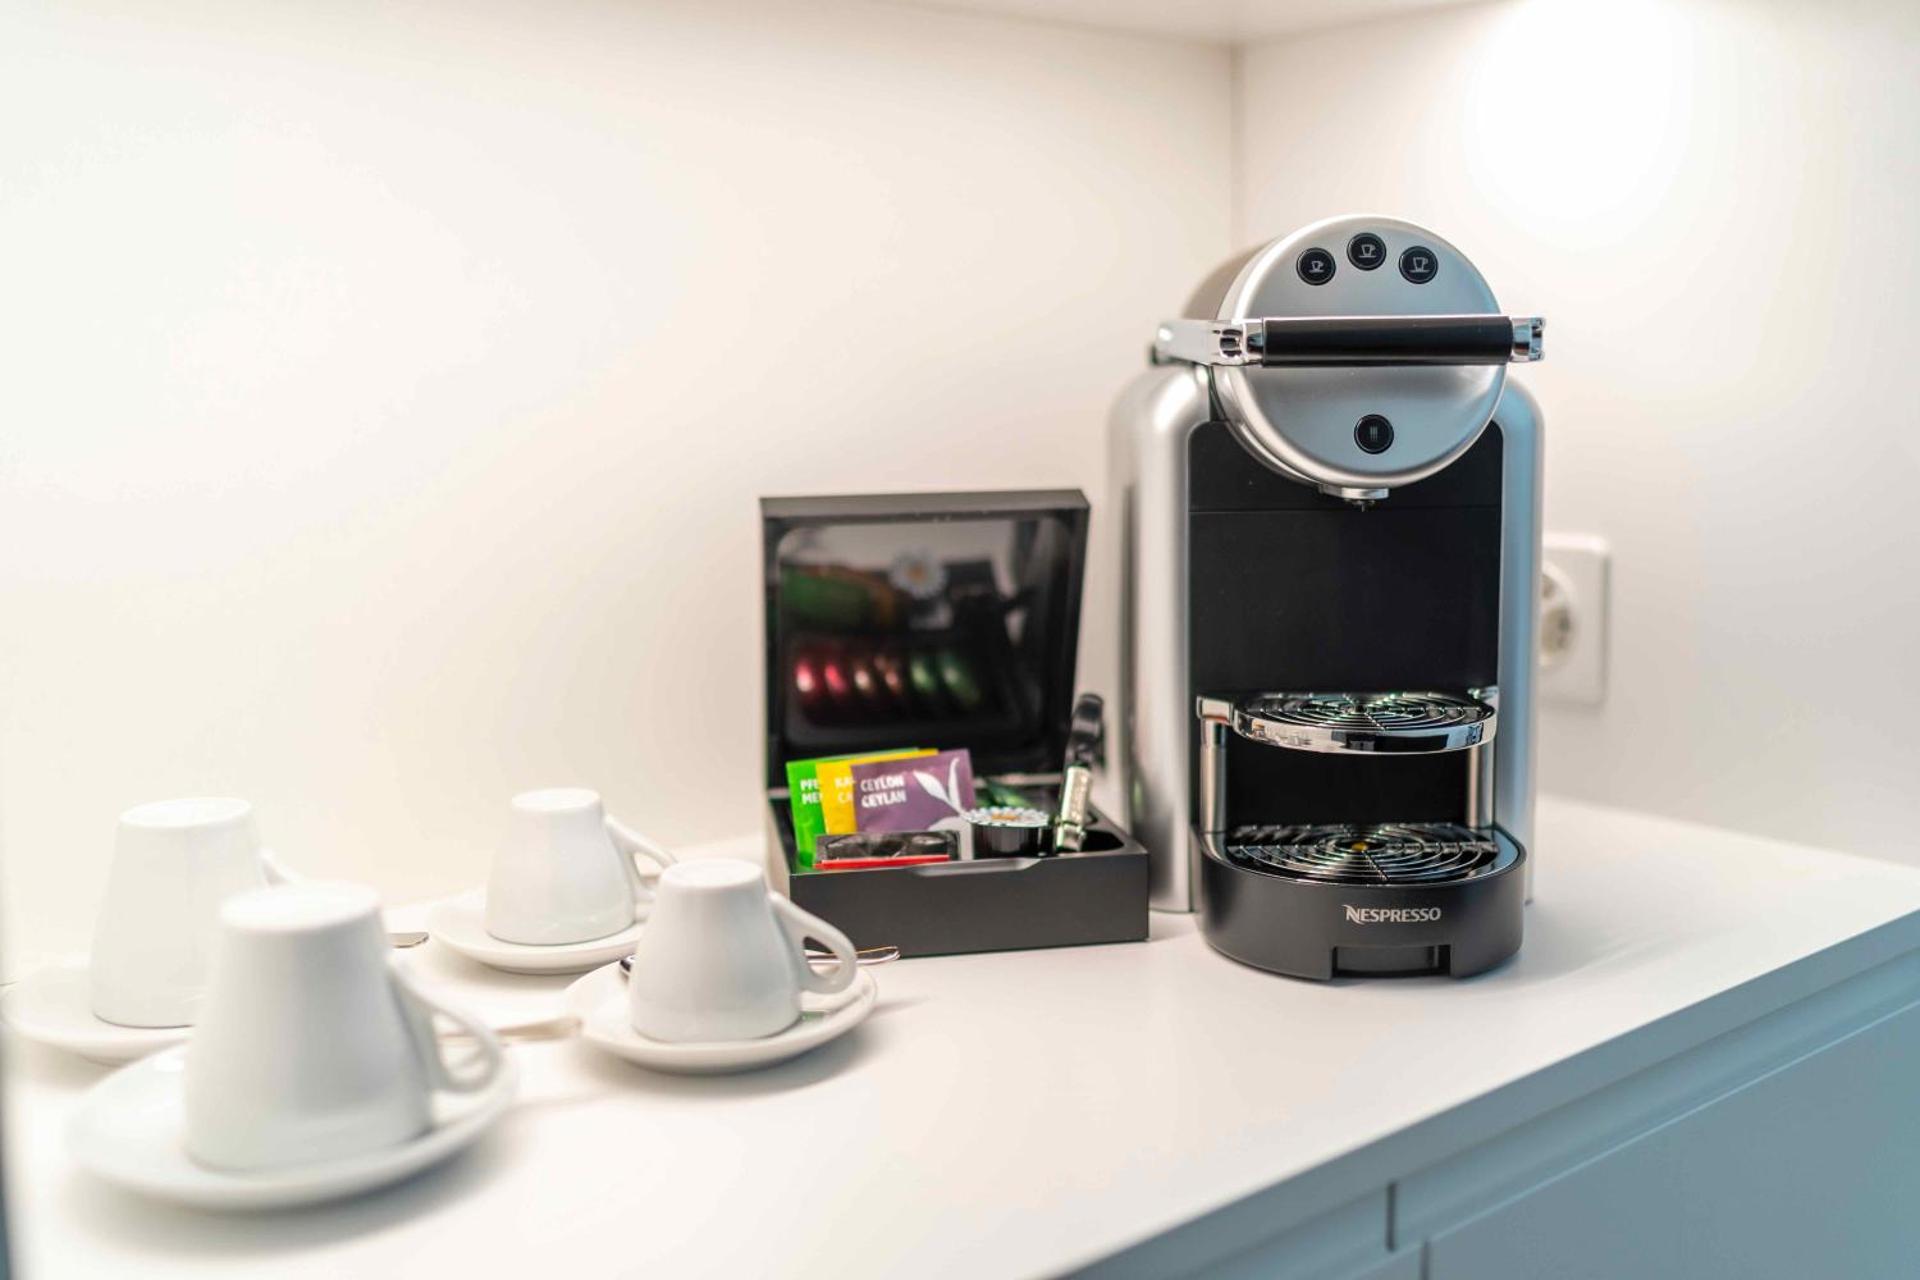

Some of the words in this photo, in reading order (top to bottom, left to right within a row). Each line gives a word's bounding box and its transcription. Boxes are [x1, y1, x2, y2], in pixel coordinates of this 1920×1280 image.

[860, 775, 905, 792] CEYLON
[861, 790, 906, 808] CEYLAN
[1343, 904, 1442, 925] NESPRESSO
